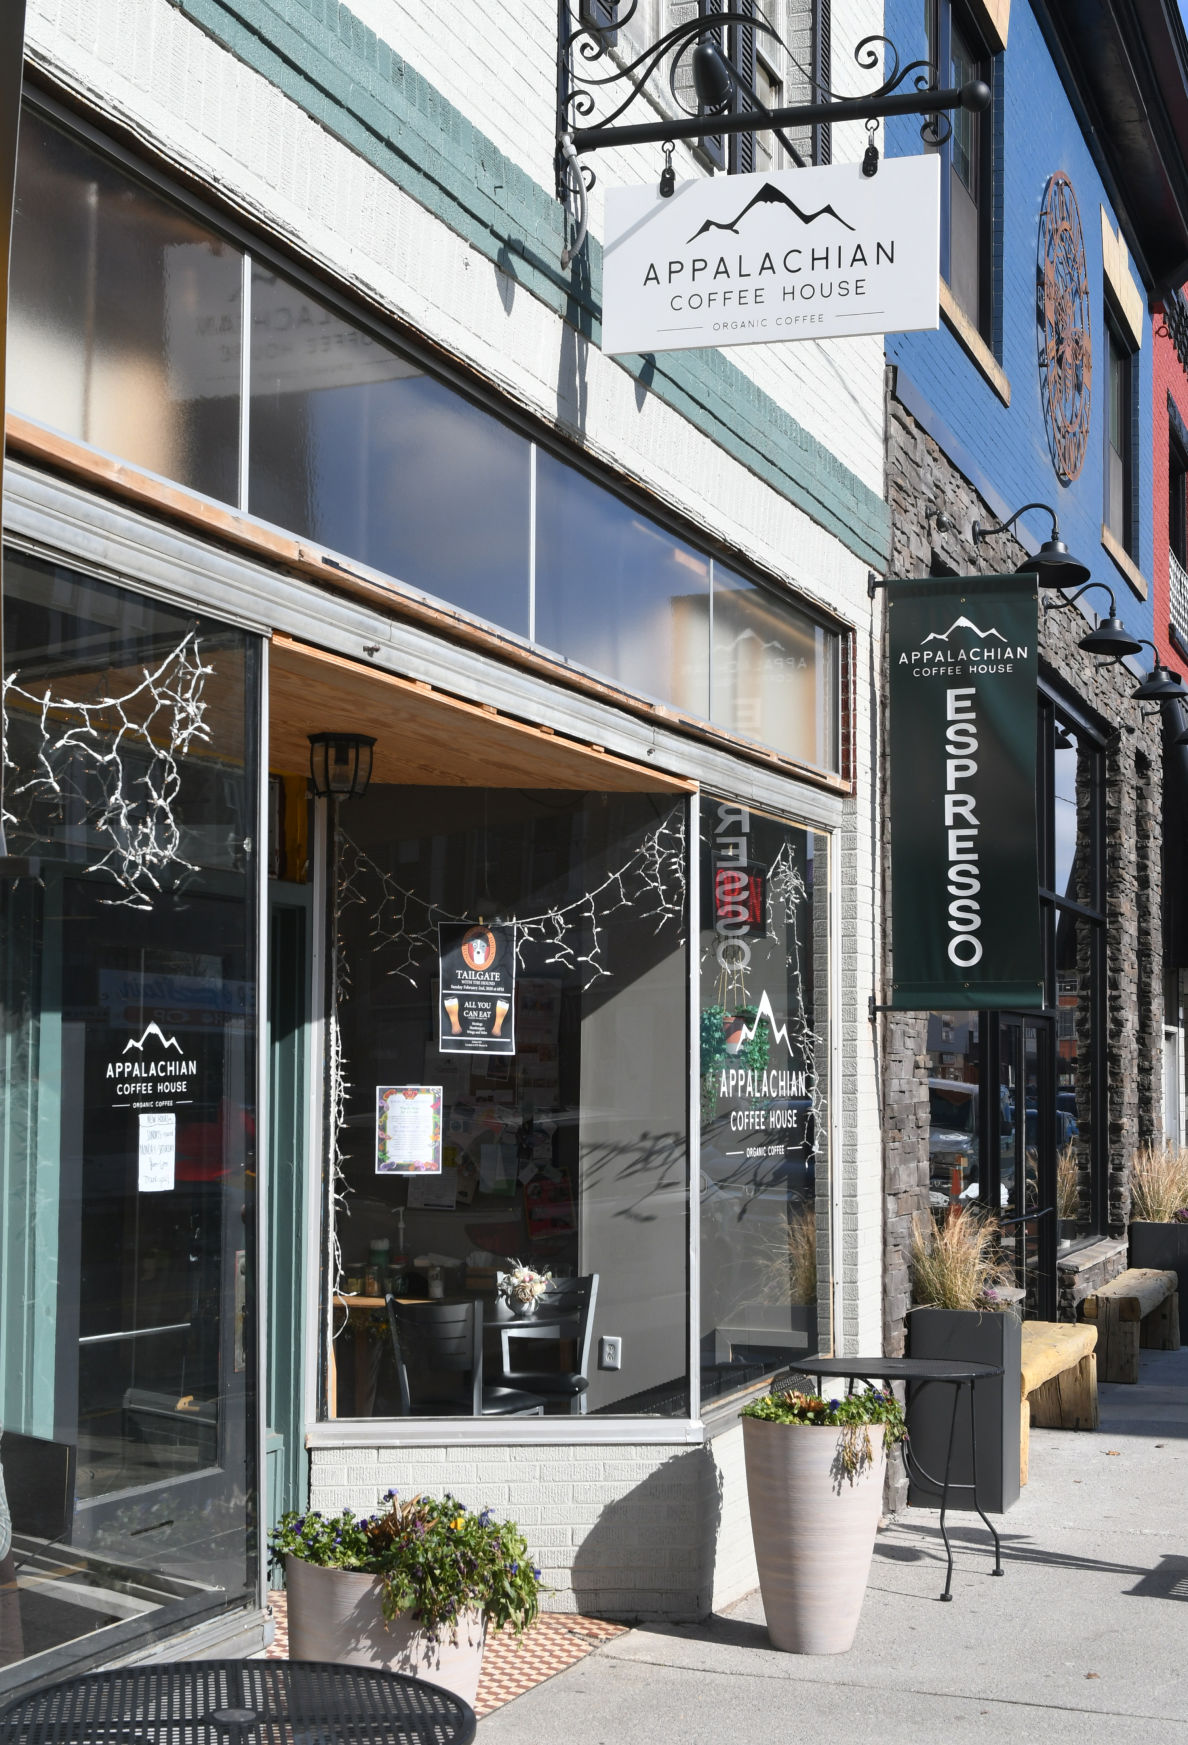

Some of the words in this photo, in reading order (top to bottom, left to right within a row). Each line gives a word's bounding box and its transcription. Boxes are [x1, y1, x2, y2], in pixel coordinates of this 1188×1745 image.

[643, 240, 895, 286] APPALACHIAN
[670, 288, 765, 311] COFFEE
[783, 279, 867, 302] HOUSE
[712, 318, 768, 331] ORGANIC
[775, 313, 825, 326] COFFEE
[898, 646, 1028, 665] APPALACHIAN
[912, 666, 962, 677] COFFEE
[969, 663, 1014, 674] HOUSE
[944, 687, 983, 968] ESPRESSO
[455, 970, 501, 981] TAILGATE
[106, 1060, 197, 1078] APPALACHIAN
[116, 1082, 153, 1095] COFFEE
[158, 1081, 187, 1093] HOUSE
[720, 1068, 806, 1098] APPALACHIAN
[132, 1101, 154, 1109] ORGANIC
[730, 1110, 766, 1131] COFFEE
[769, 1109, 798, 1129] HOUSE
[746, 1147, 766, 1158] ORGANIC
[768, 1145, 785, 1156] COFFEE
